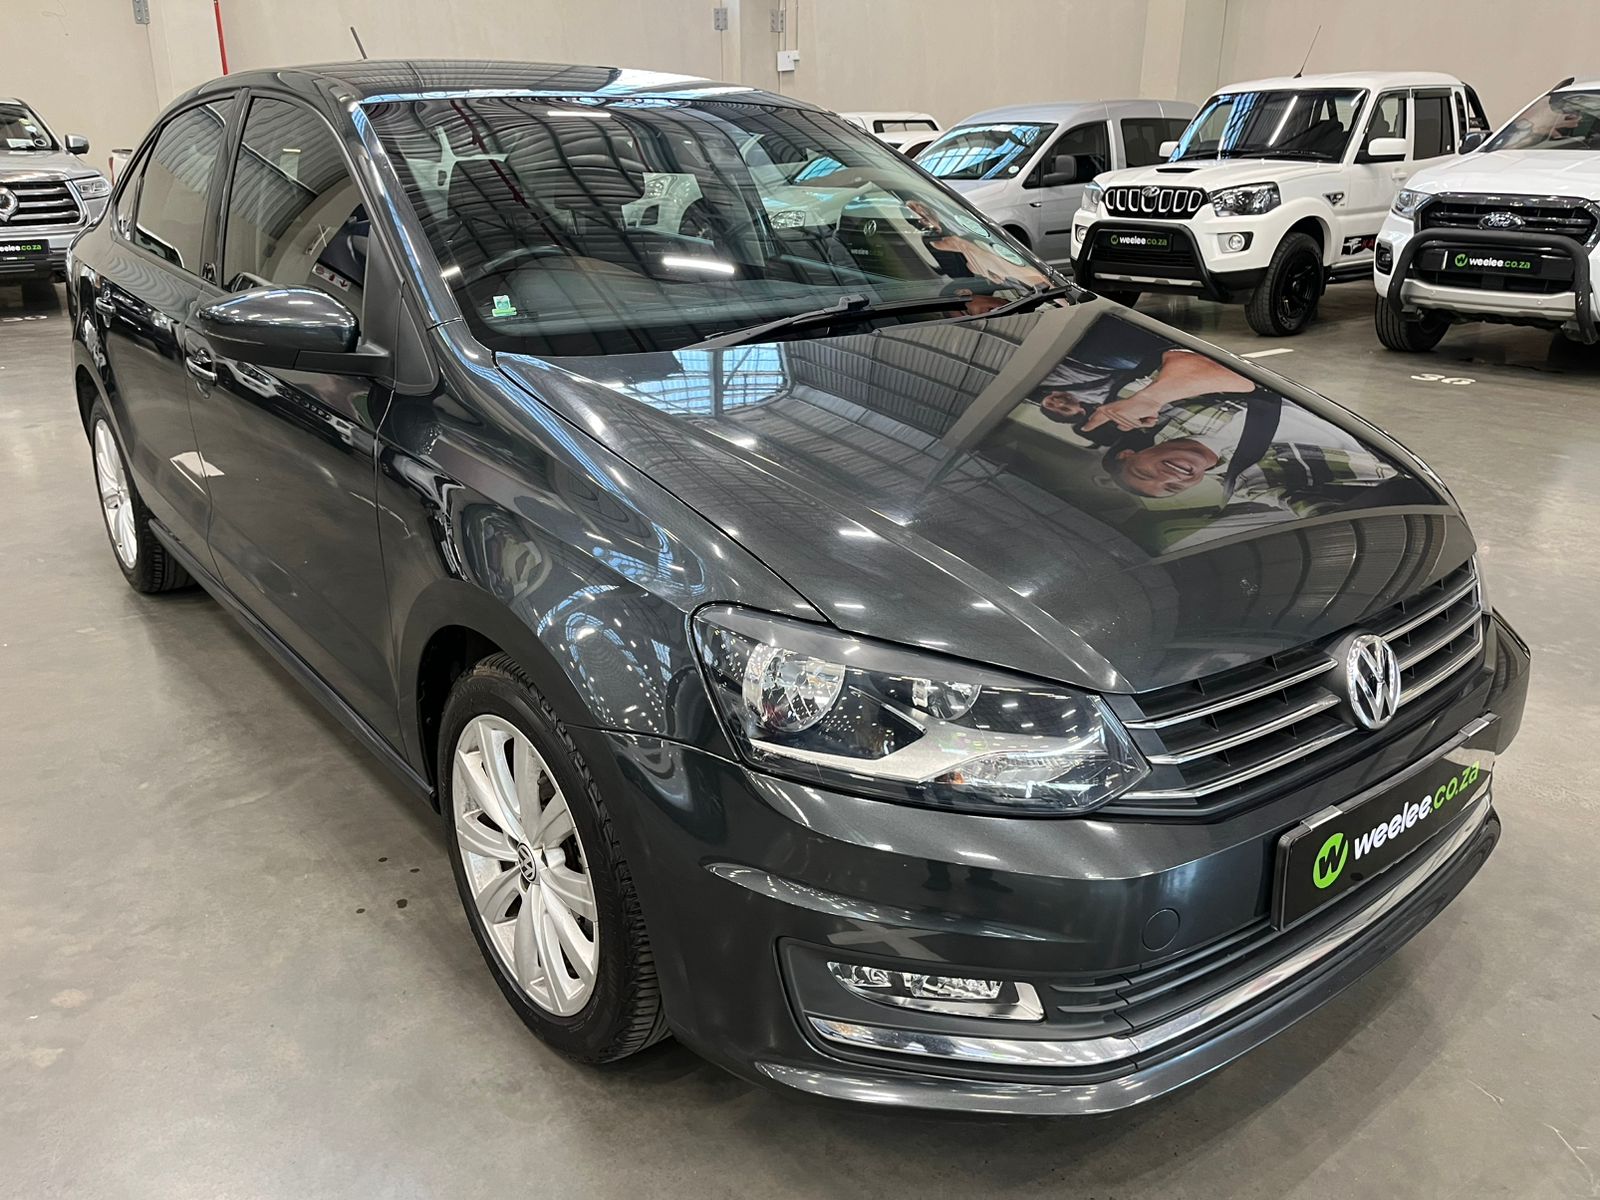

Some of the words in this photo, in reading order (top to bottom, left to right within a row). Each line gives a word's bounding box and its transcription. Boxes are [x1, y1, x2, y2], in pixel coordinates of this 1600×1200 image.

[1487, 212, 1511, 228] Ford
[1119, 235, 1168, 246] weelee.co.za
[0, 244, 42, 252] eelee.co.za
[1469, 257, 1531, 269] weelee.co.za
[1410, 373, 1476, 385] 36
[1354, 760, 1480, 860] weelee.co.za
